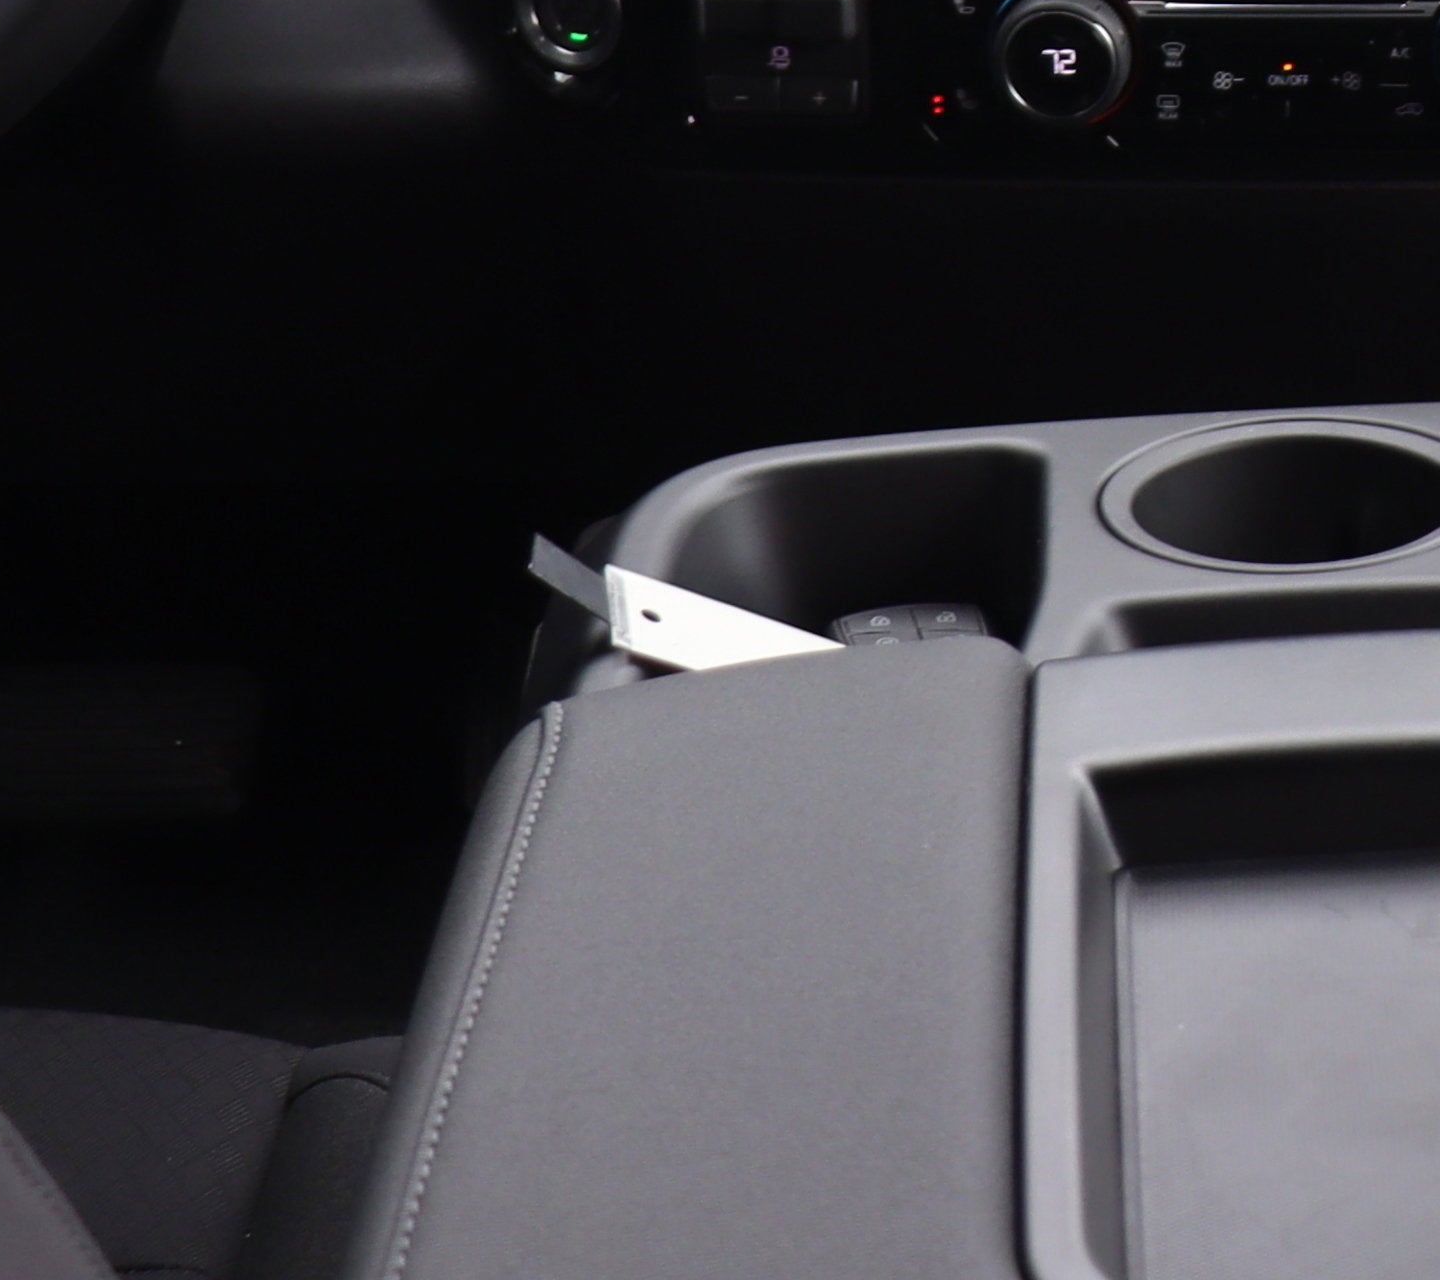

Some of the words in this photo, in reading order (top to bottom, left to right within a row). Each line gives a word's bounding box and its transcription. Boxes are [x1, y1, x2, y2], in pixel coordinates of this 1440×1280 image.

[1390, 48, 1409, 58] A/C
[1041, 48, 1077, 75] 72
[1268, 74, 1309, 86] ON/OFF
